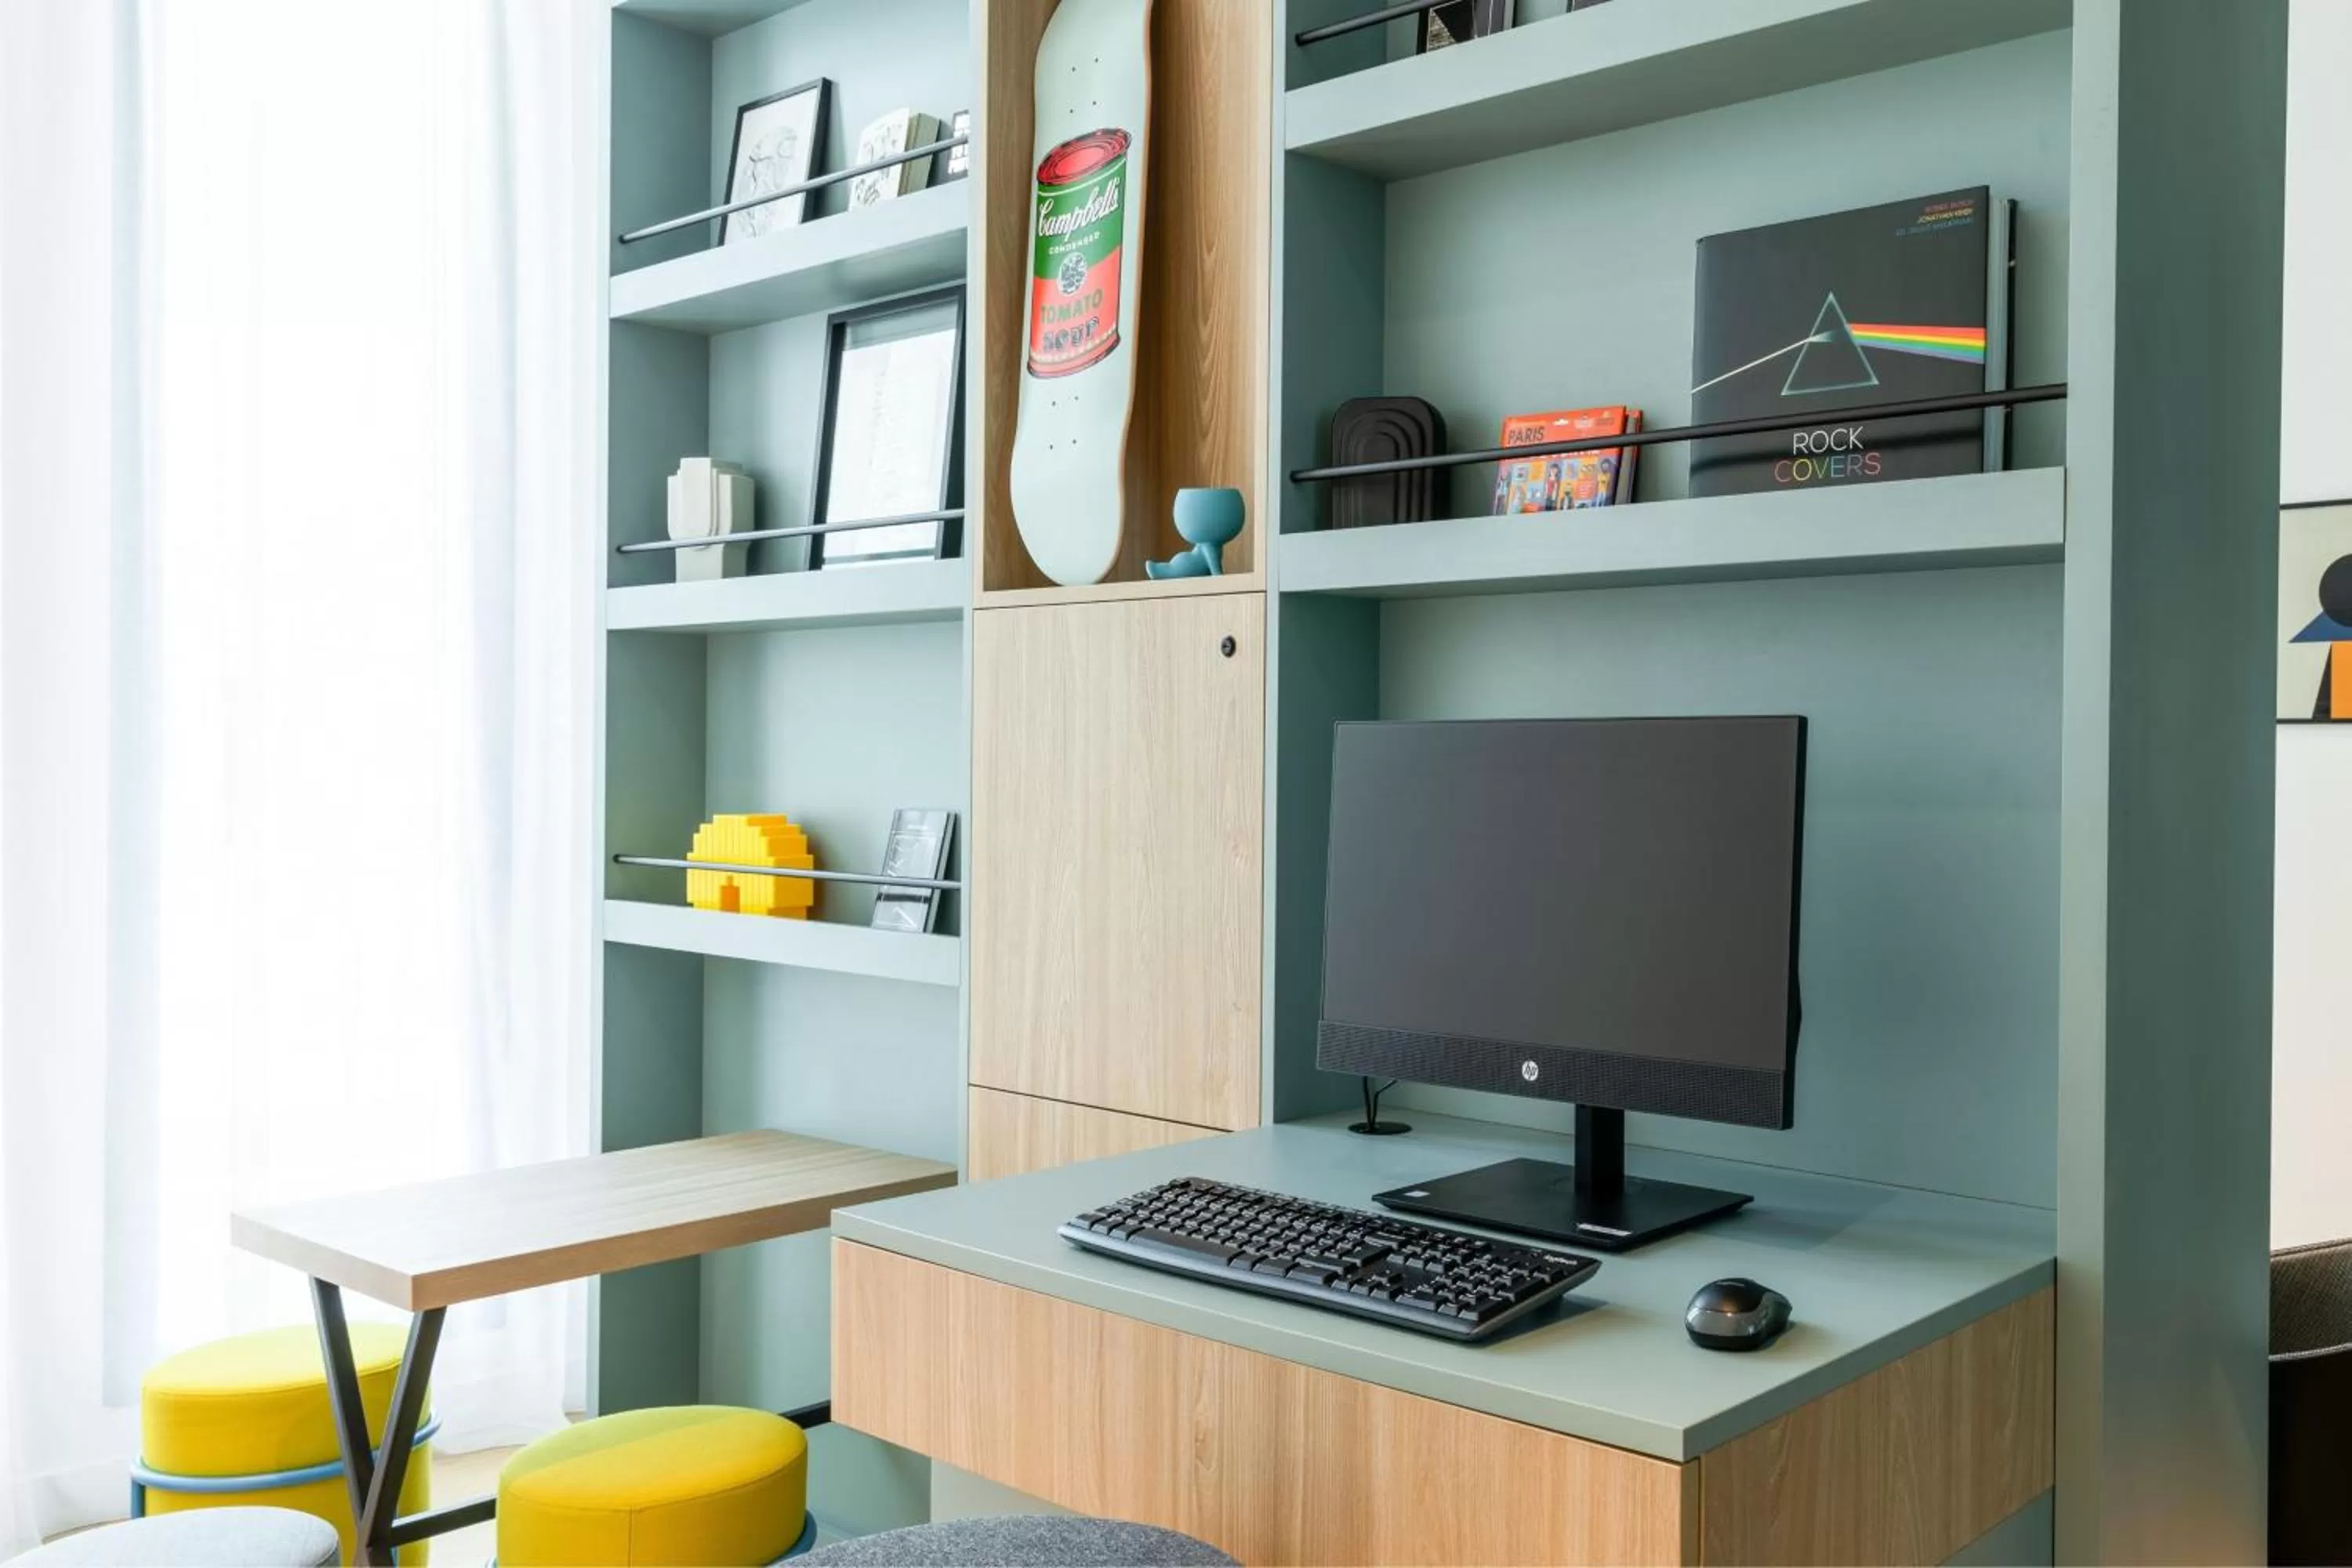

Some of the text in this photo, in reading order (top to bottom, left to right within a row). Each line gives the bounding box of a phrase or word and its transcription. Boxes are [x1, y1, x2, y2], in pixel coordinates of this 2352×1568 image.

[1037, 176, 1120, 241] Campbell's
[1040, 288, 1103, 324] TOMATO
[1043, 316, 1100, 353] SOUP
[1507, 426, 1545, 445] PARIS
[1792, 426, 1864, 455] ROCK
[1773, 452, 1882, 484] COVERS
